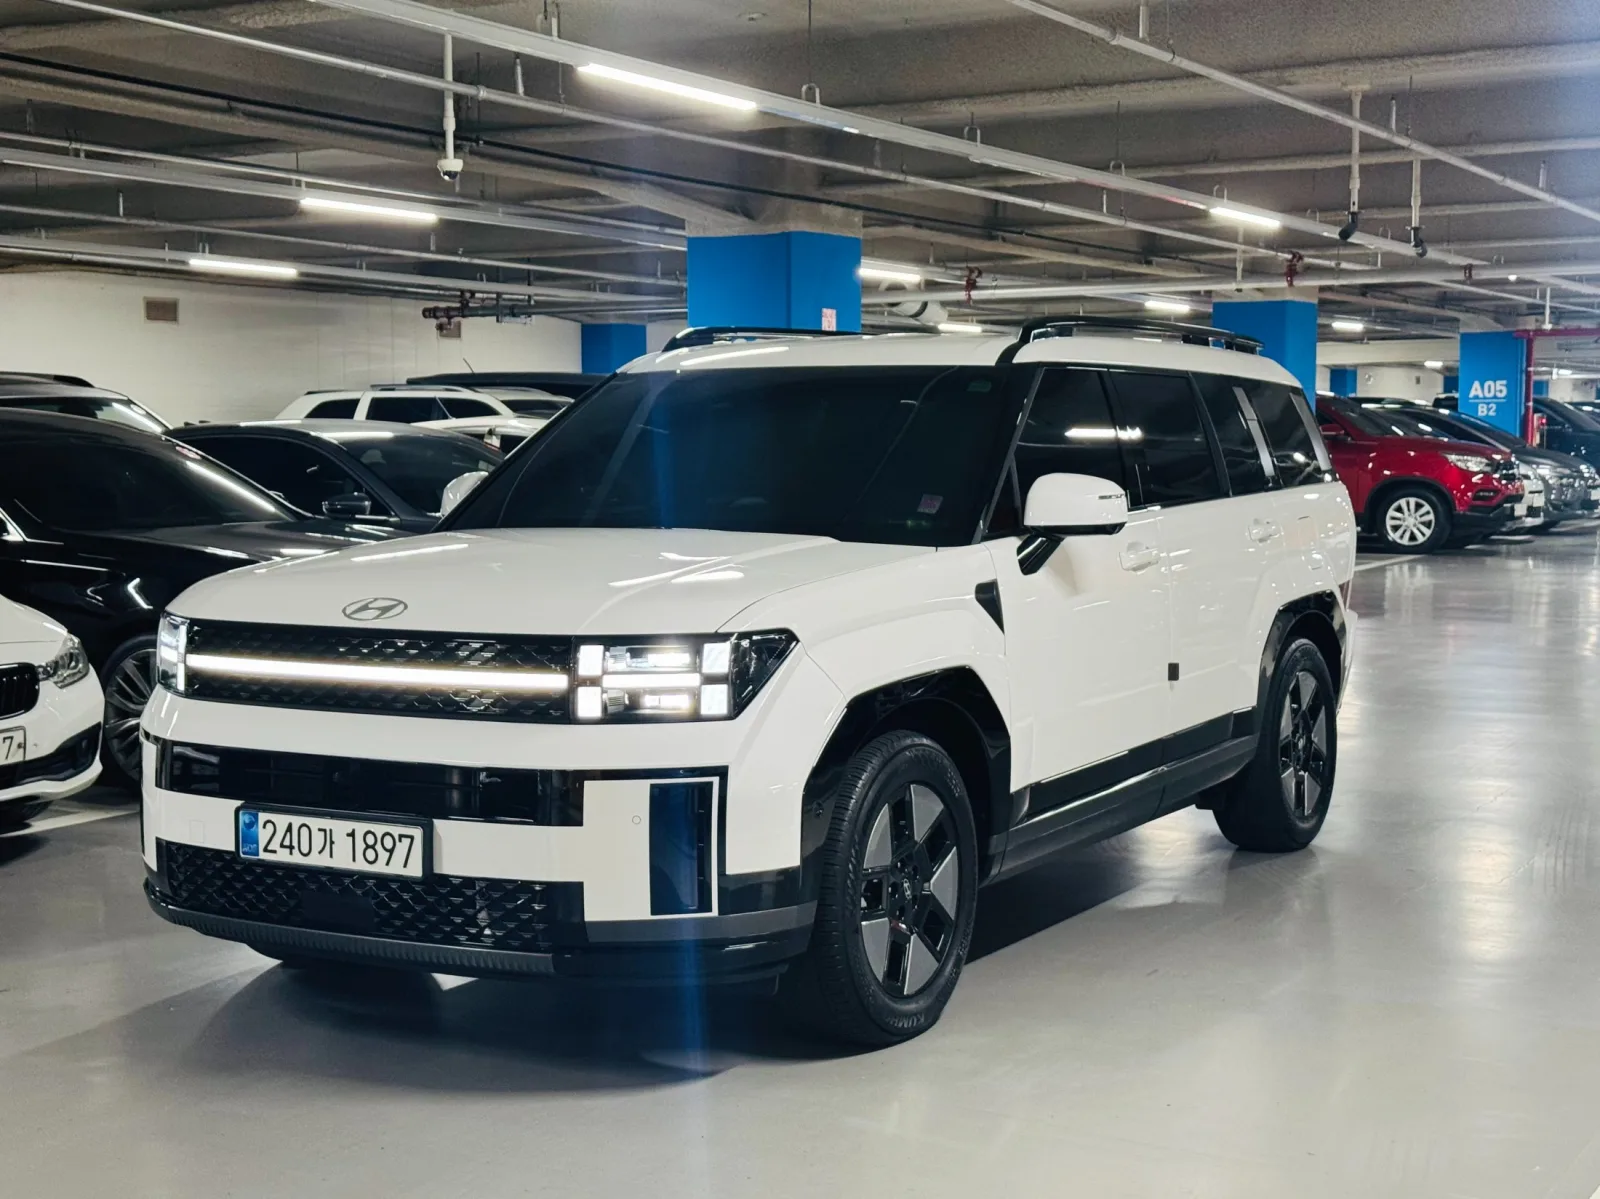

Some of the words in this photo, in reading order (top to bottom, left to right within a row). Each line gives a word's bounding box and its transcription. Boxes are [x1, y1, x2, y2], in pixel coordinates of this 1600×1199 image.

[1468, 380, 1508, 398] A05
[1477, 403, 1497, 417] B2
[262, 819, 335, 859] 240가
[346, 828, 415, 869] 1897
